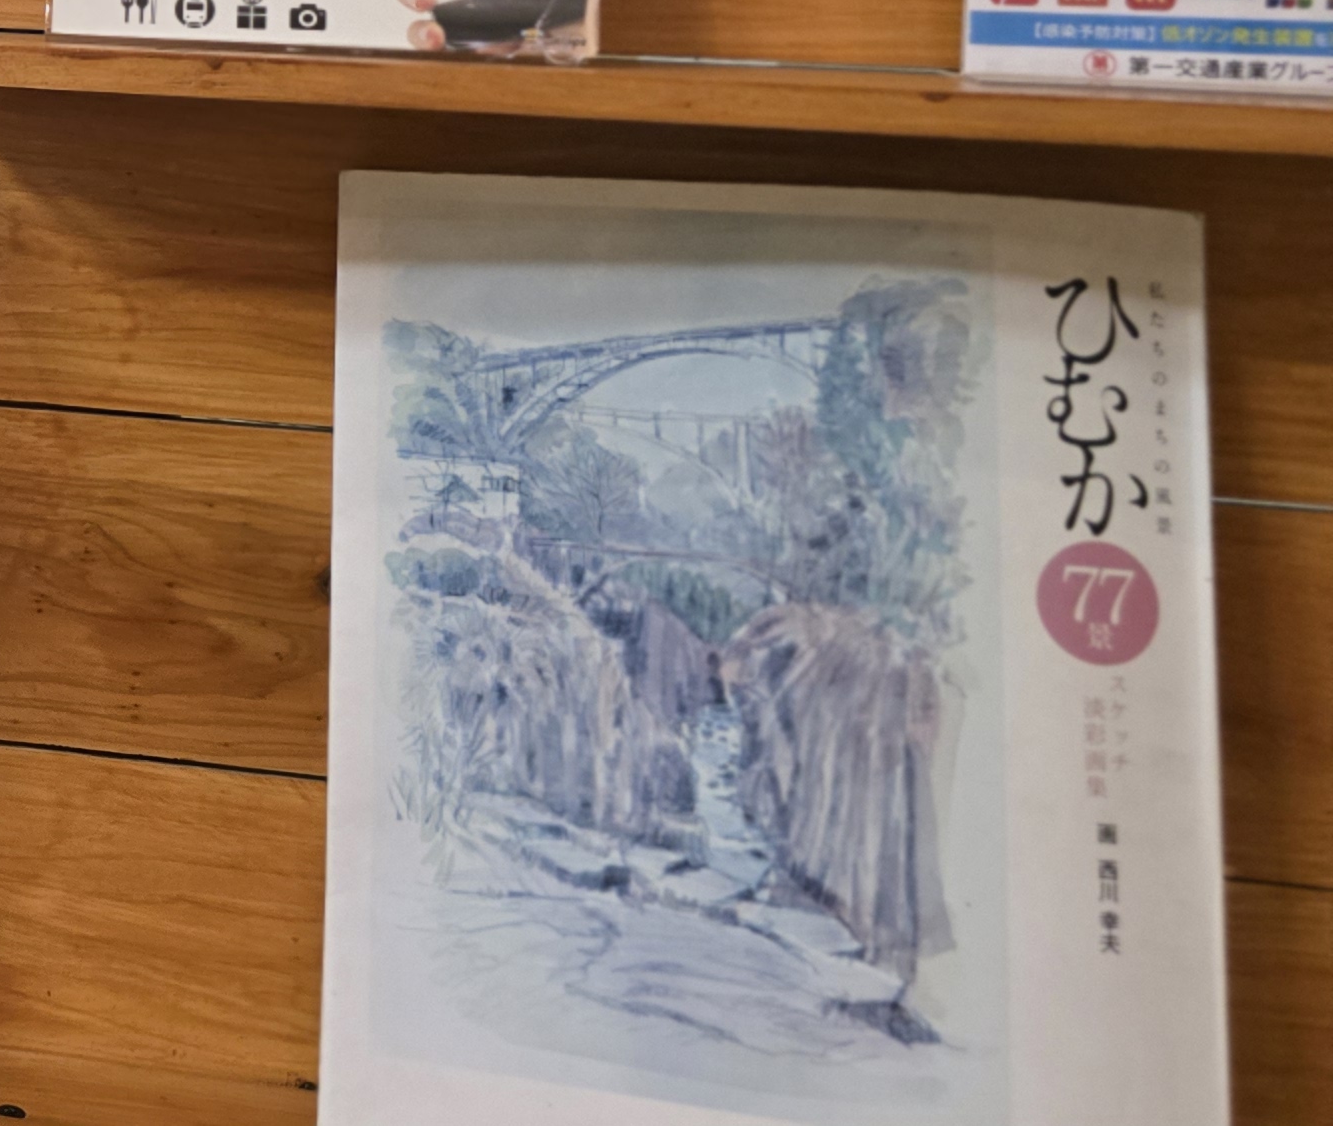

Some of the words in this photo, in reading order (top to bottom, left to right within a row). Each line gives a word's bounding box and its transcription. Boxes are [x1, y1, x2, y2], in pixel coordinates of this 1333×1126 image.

[1042, 275, 1149, 536] ひむか
[1062, 564, 1135, 627] 77
